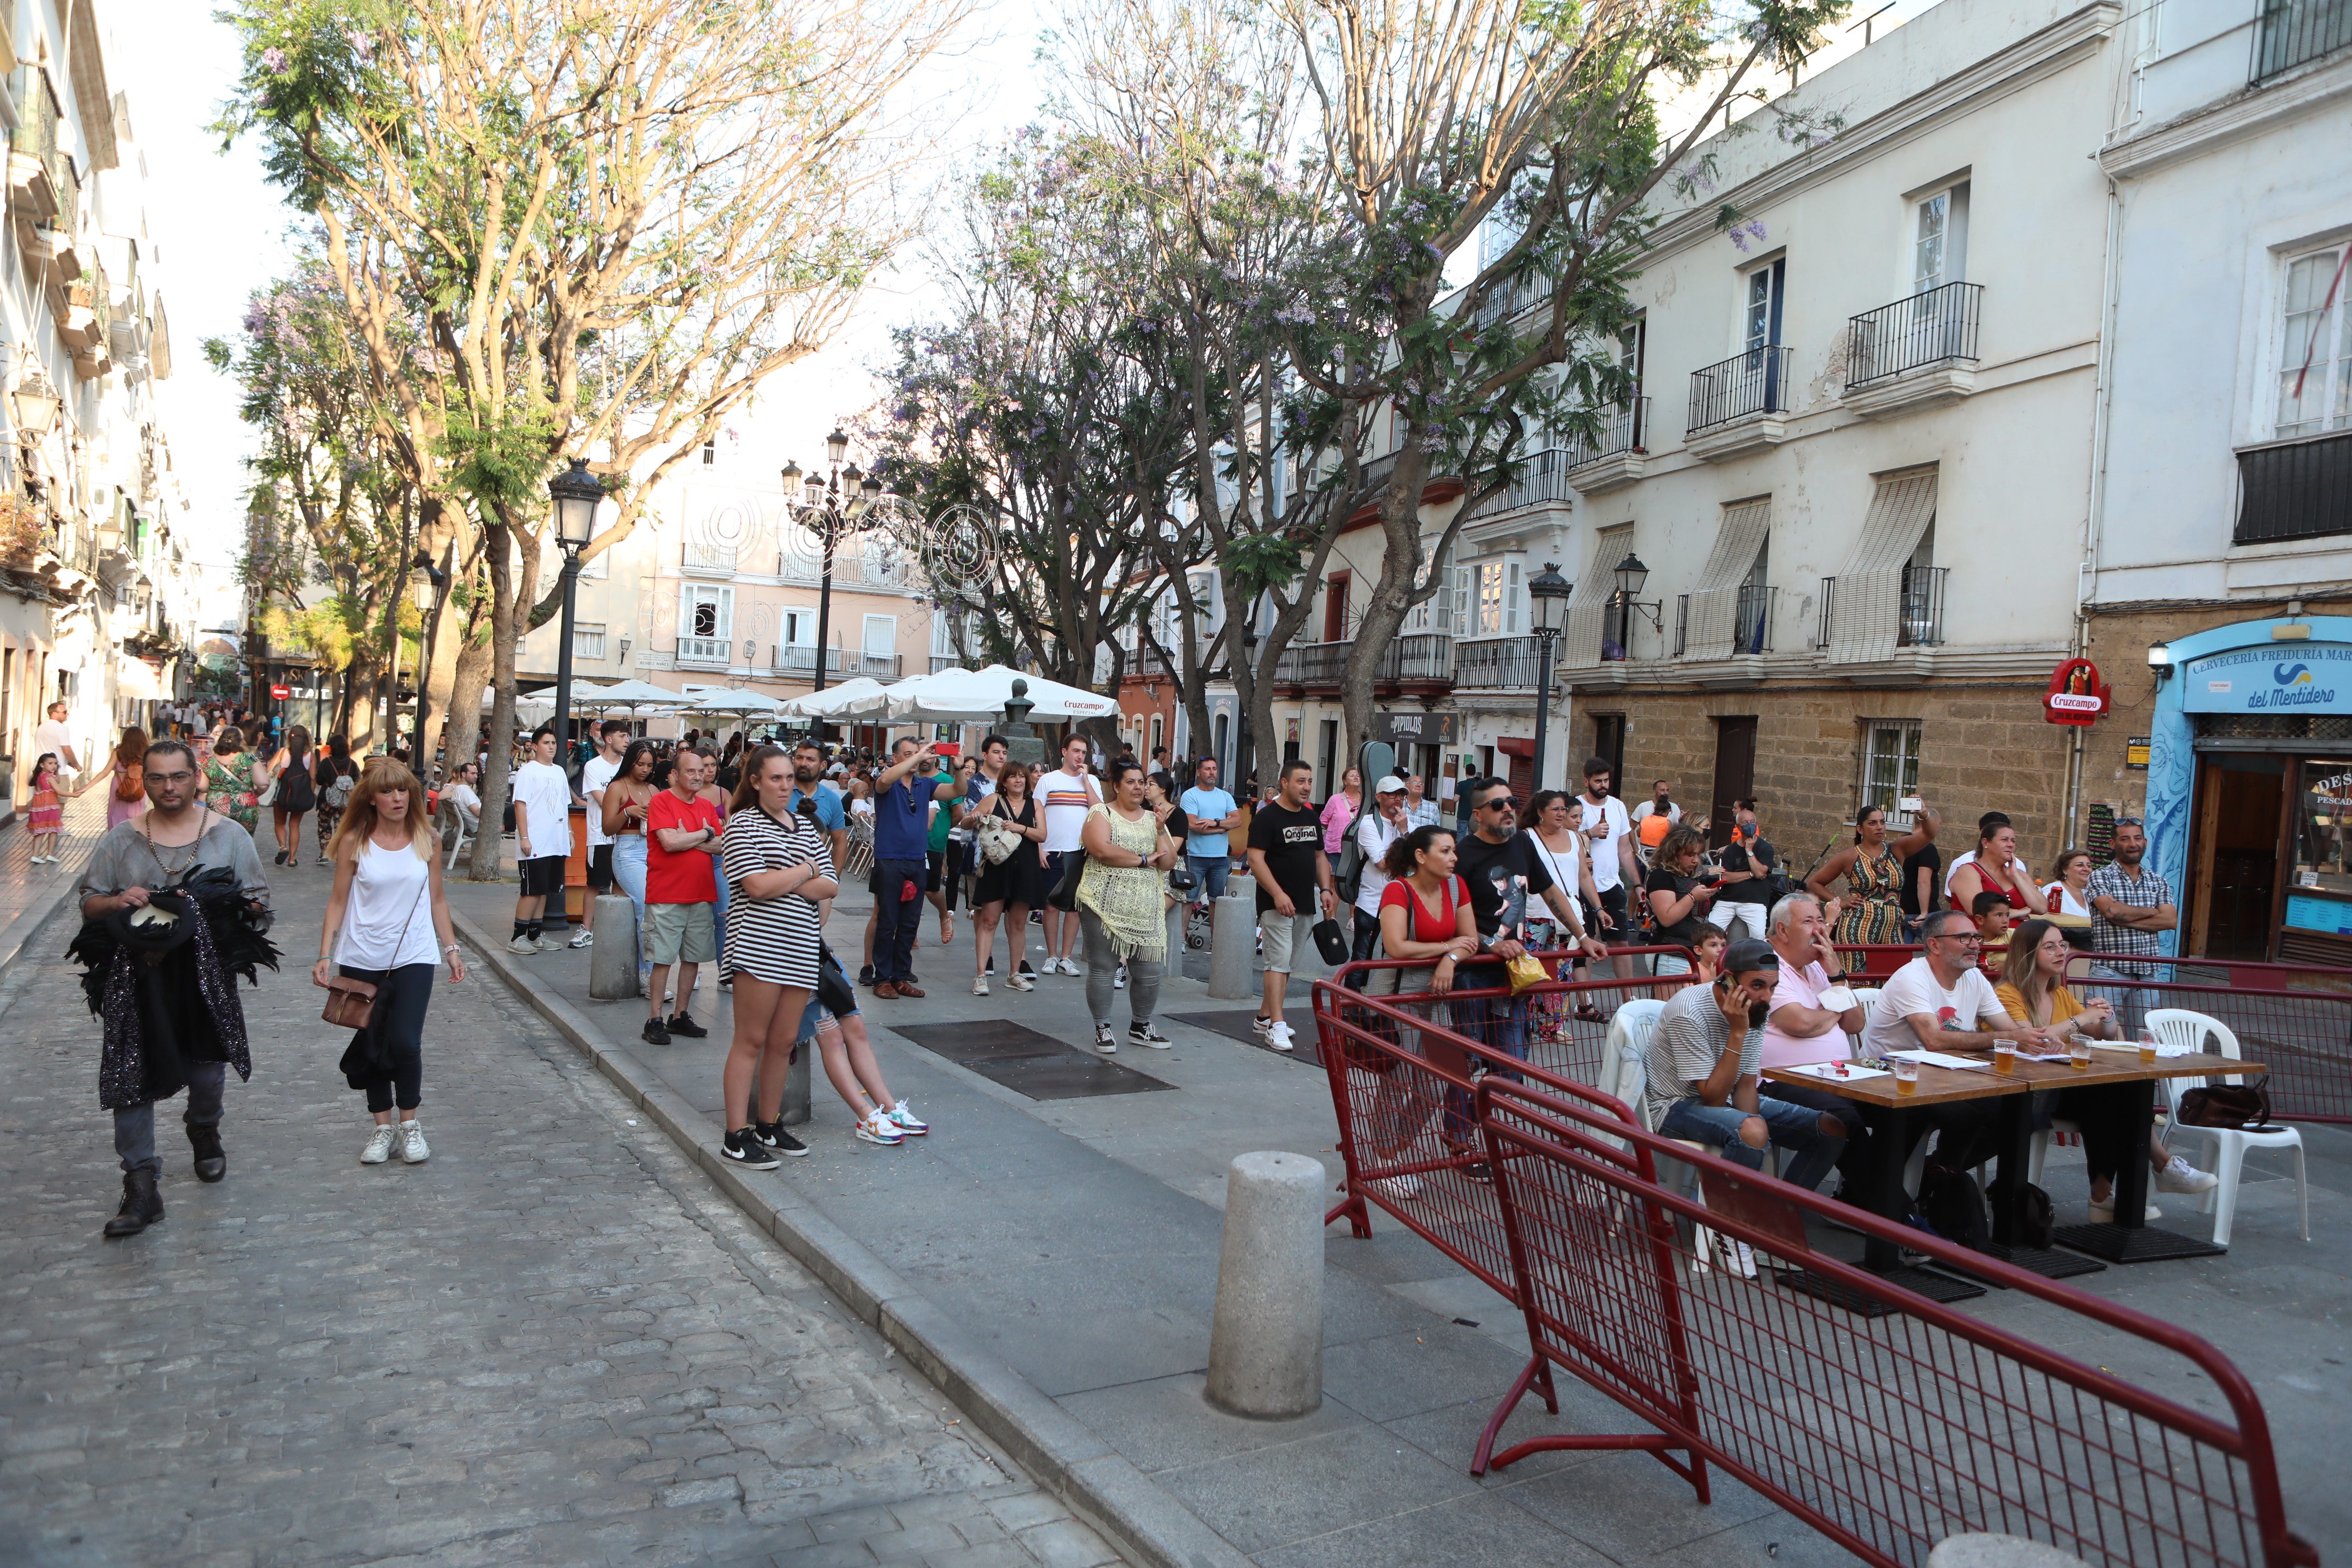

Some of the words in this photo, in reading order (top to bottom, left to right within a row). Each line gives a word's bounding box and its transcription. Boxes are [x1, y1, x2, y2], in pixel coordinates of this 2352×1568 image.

[2193, 650, 2259, 674] CERVECERÍA
[2261, 646, 2322, 661] FREIDURÍA
[1064, 700, 1104, 710] Cruzcampo
[2054, 696, 2097, 710] Cruzcampo
[2248, 690, 2267, 708] del
[2270, 687, 2335, 707] Mentidero
[1393, 716, 1422, 734] PIPIOLOS
[1285, 827, 1316, 840] Original
